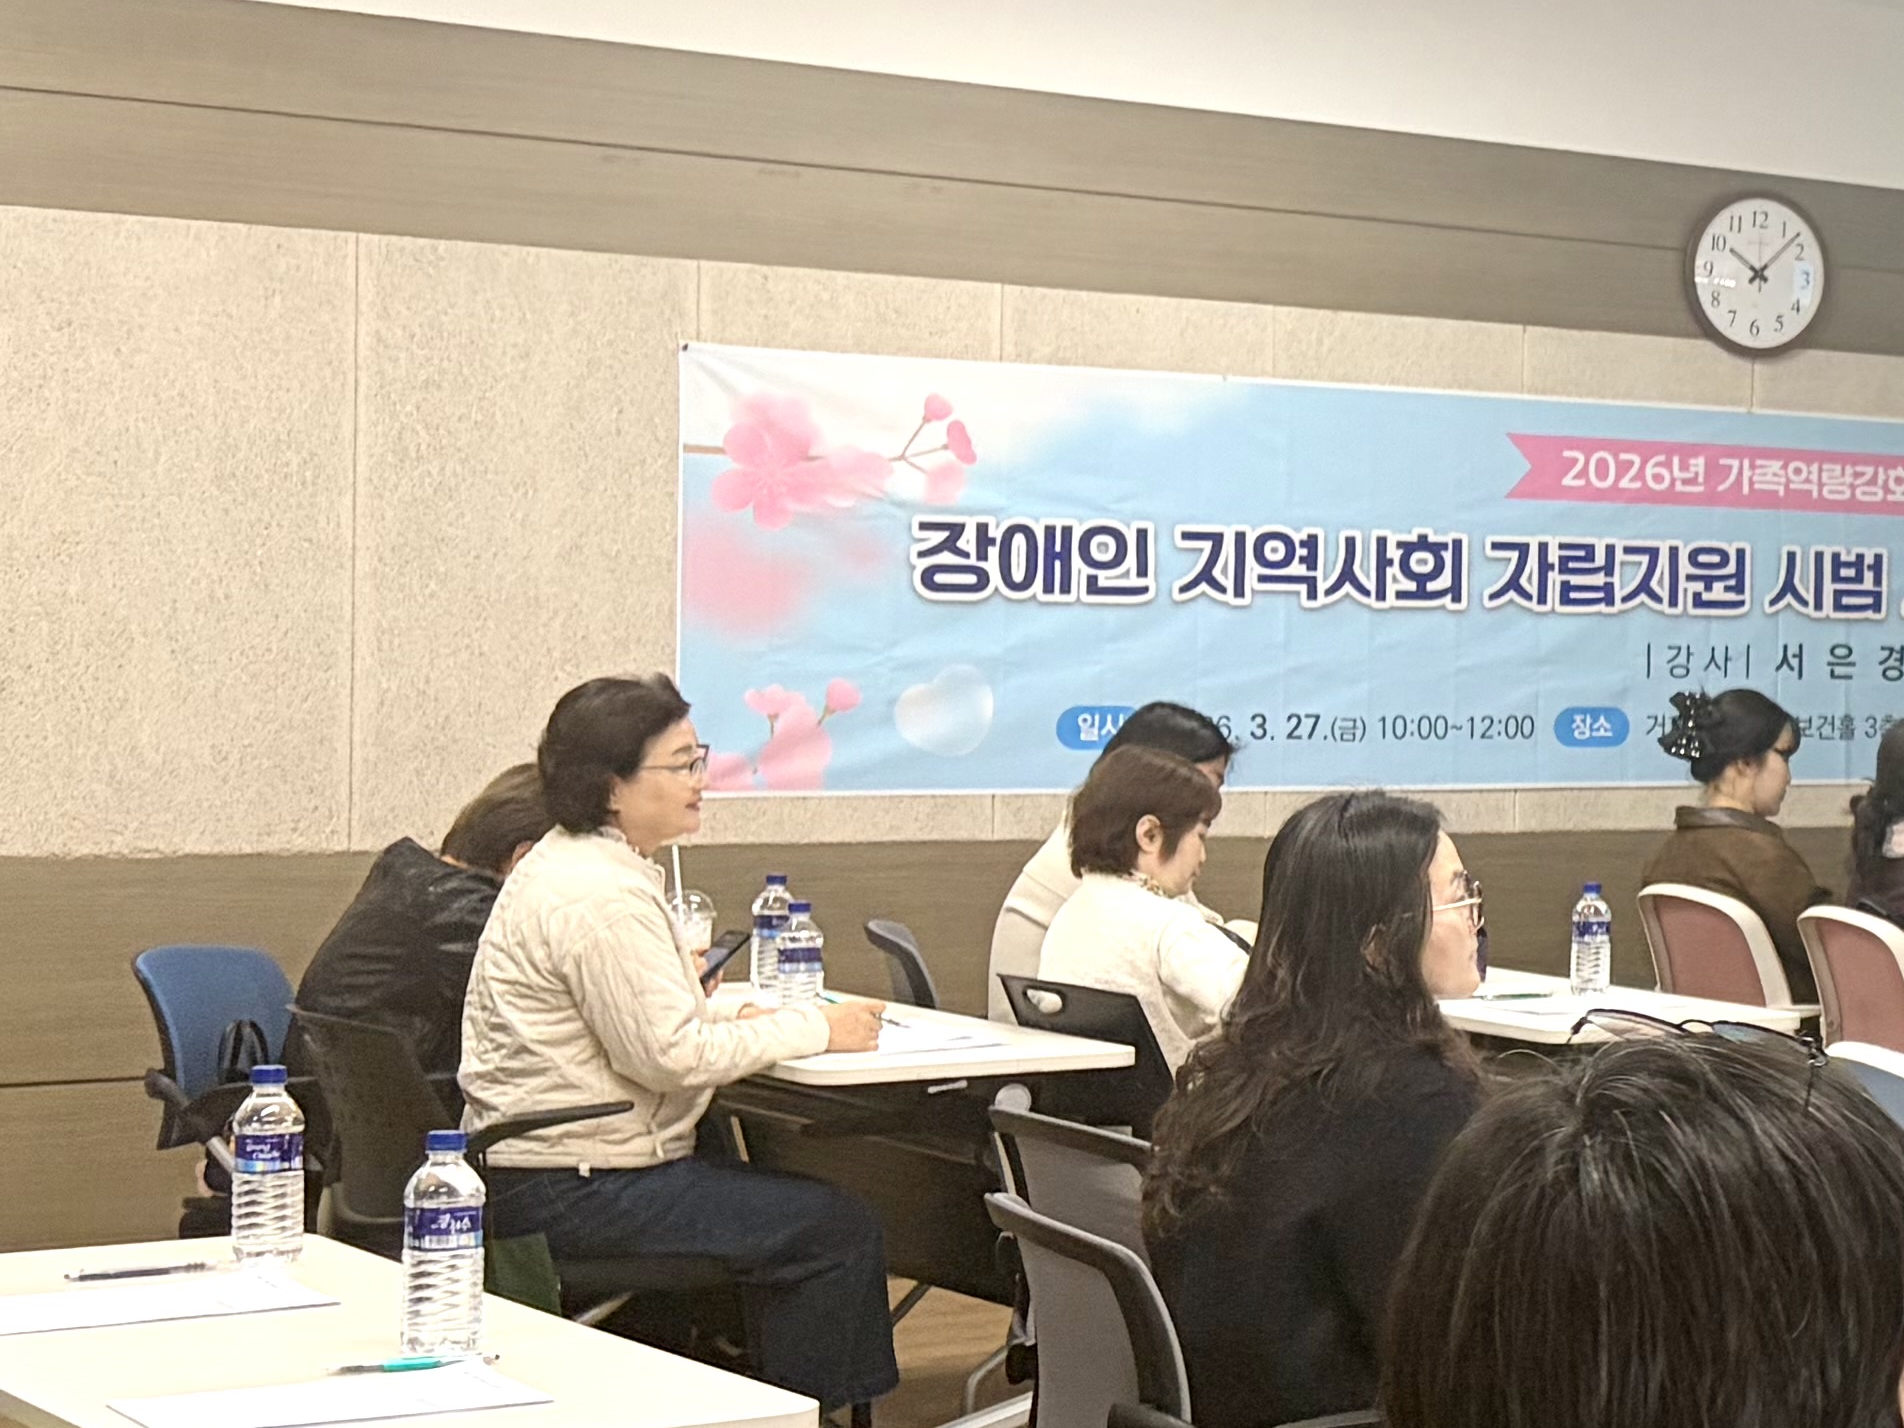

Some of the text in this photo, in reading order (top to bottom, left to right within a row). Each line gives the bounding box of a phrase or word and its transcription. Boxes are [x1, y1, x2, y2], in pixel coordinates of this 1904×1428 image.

[1729, 214, 1742, 234] 11
[1752, 211, 1769, 229] 12
[1781, 220, 1787, 239] 1
[1711, 233, 1727, 252] 10
[1794, 243, 1805, 261] 2
[1703, 260, 1714, 277] 9
[1800, 270, 1810, 290] 3
[1711, 290, 1721, 308] 8
[1791, 298, 1801, 315] 4
[1727, 309, 1737, 327] 7
[1749, 318, 1760, 337] 6
[1773, 314, 1784, 332] 5
[1561, 450, 1706, 494] 2026년
[914, 518, 1152, 598] 장애인
[1176, 527, 1465, 606] 지역사회
[1486, 537, 1749, 613] 자립지원
[1766, 547, 1885, 616] 시범
[1249, 713, 1275, 741] 3.
[1377, 714, 1535, 741] 10:00~12:00
[1571, 713, 1614, 741] 장소
